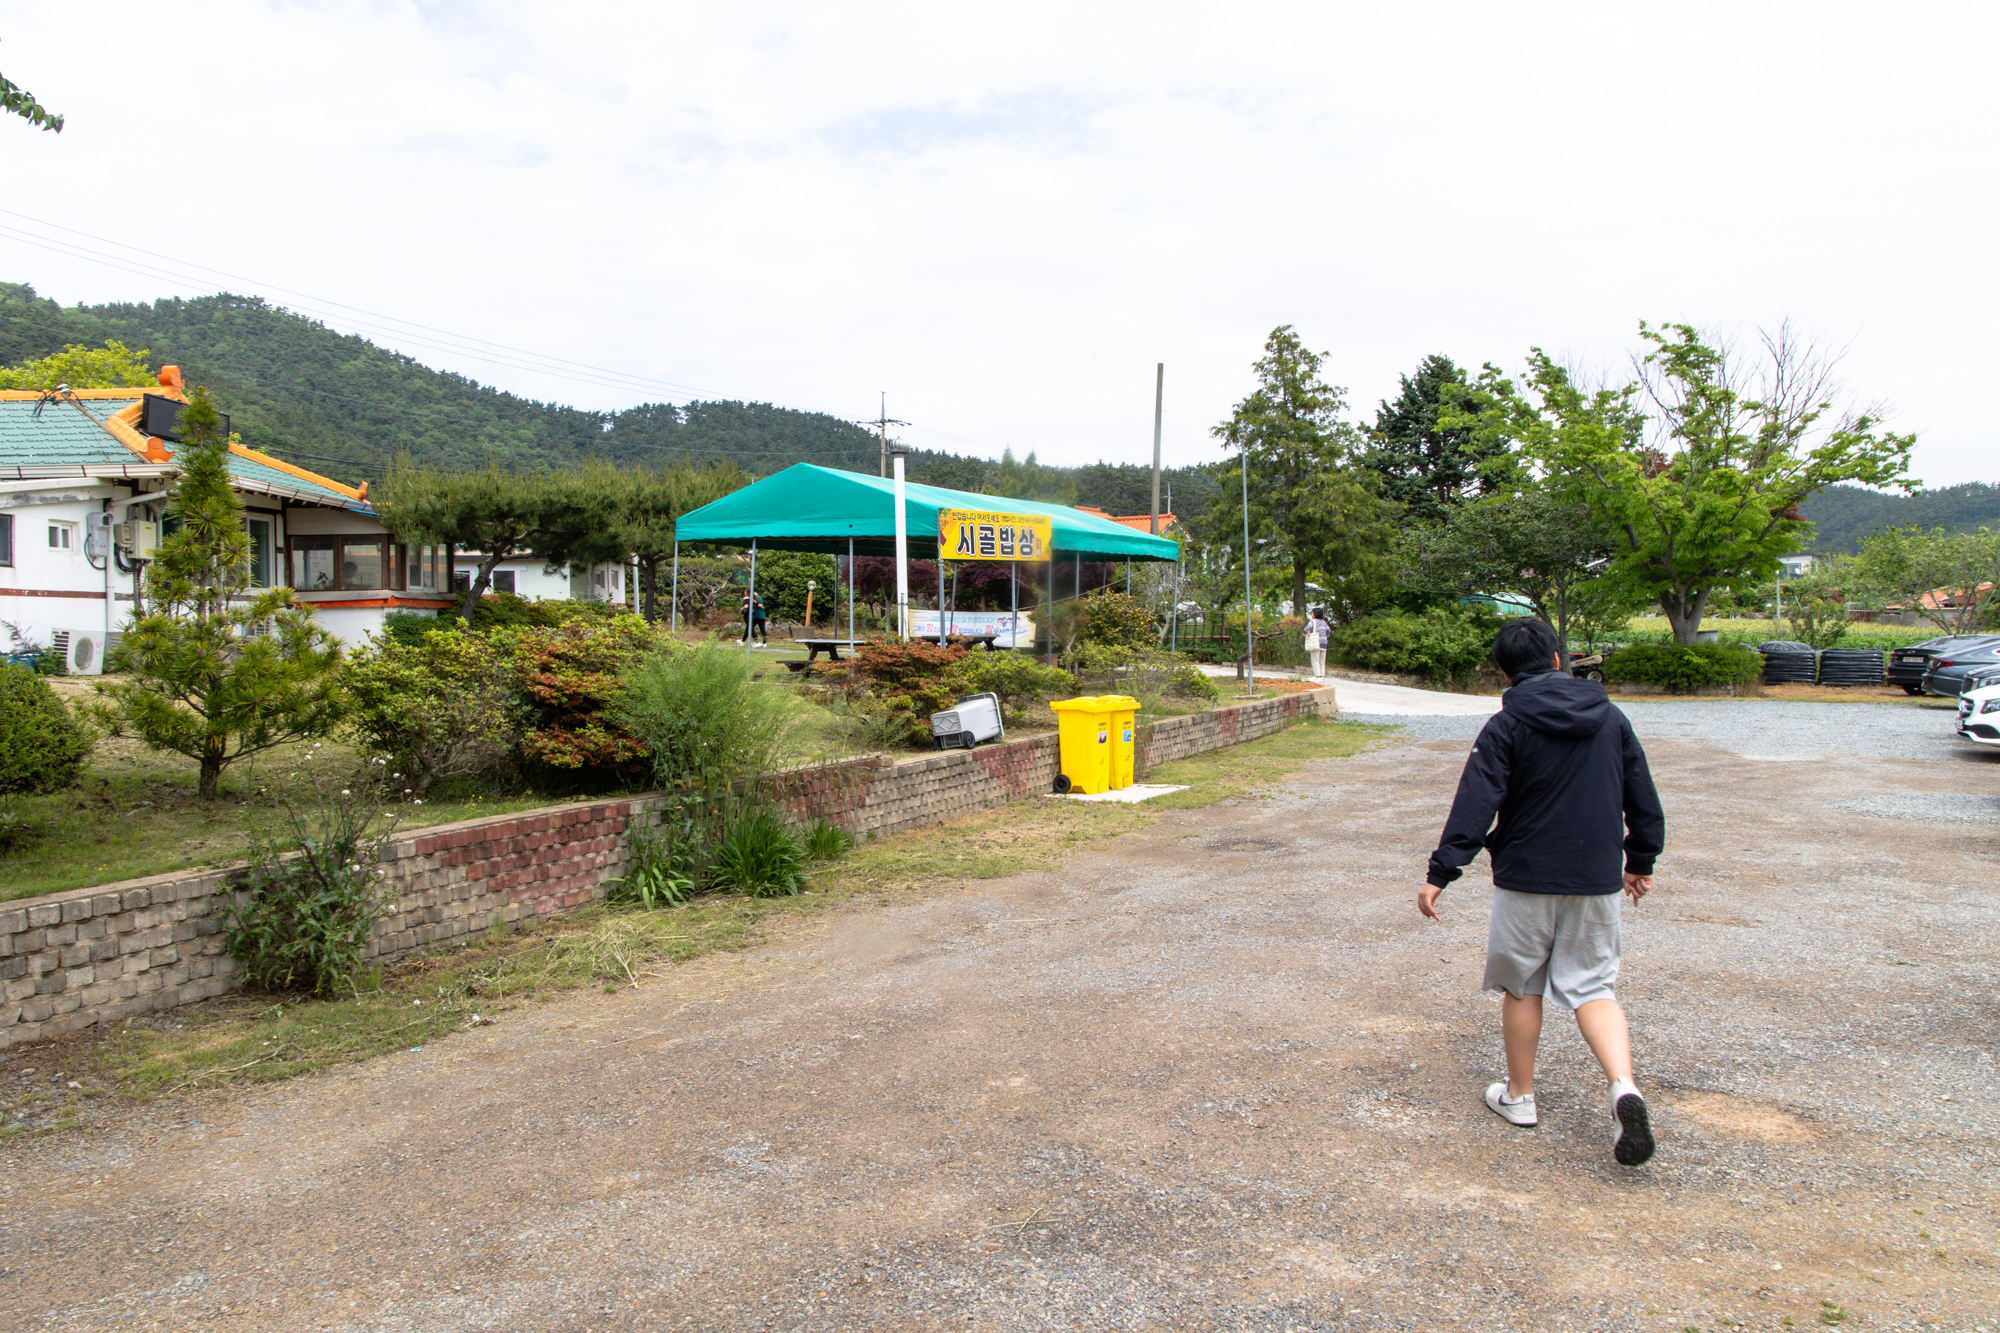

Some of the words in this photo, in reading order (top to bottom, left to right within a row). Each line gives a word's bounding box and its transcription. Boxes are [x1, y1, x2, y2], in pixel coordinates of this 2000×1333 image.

[952, 511, 976, 521] 반갑습니다
[977, 513, 1000, 523] 어서오세요
[957, 524, 1035, 557] 시골밥상
